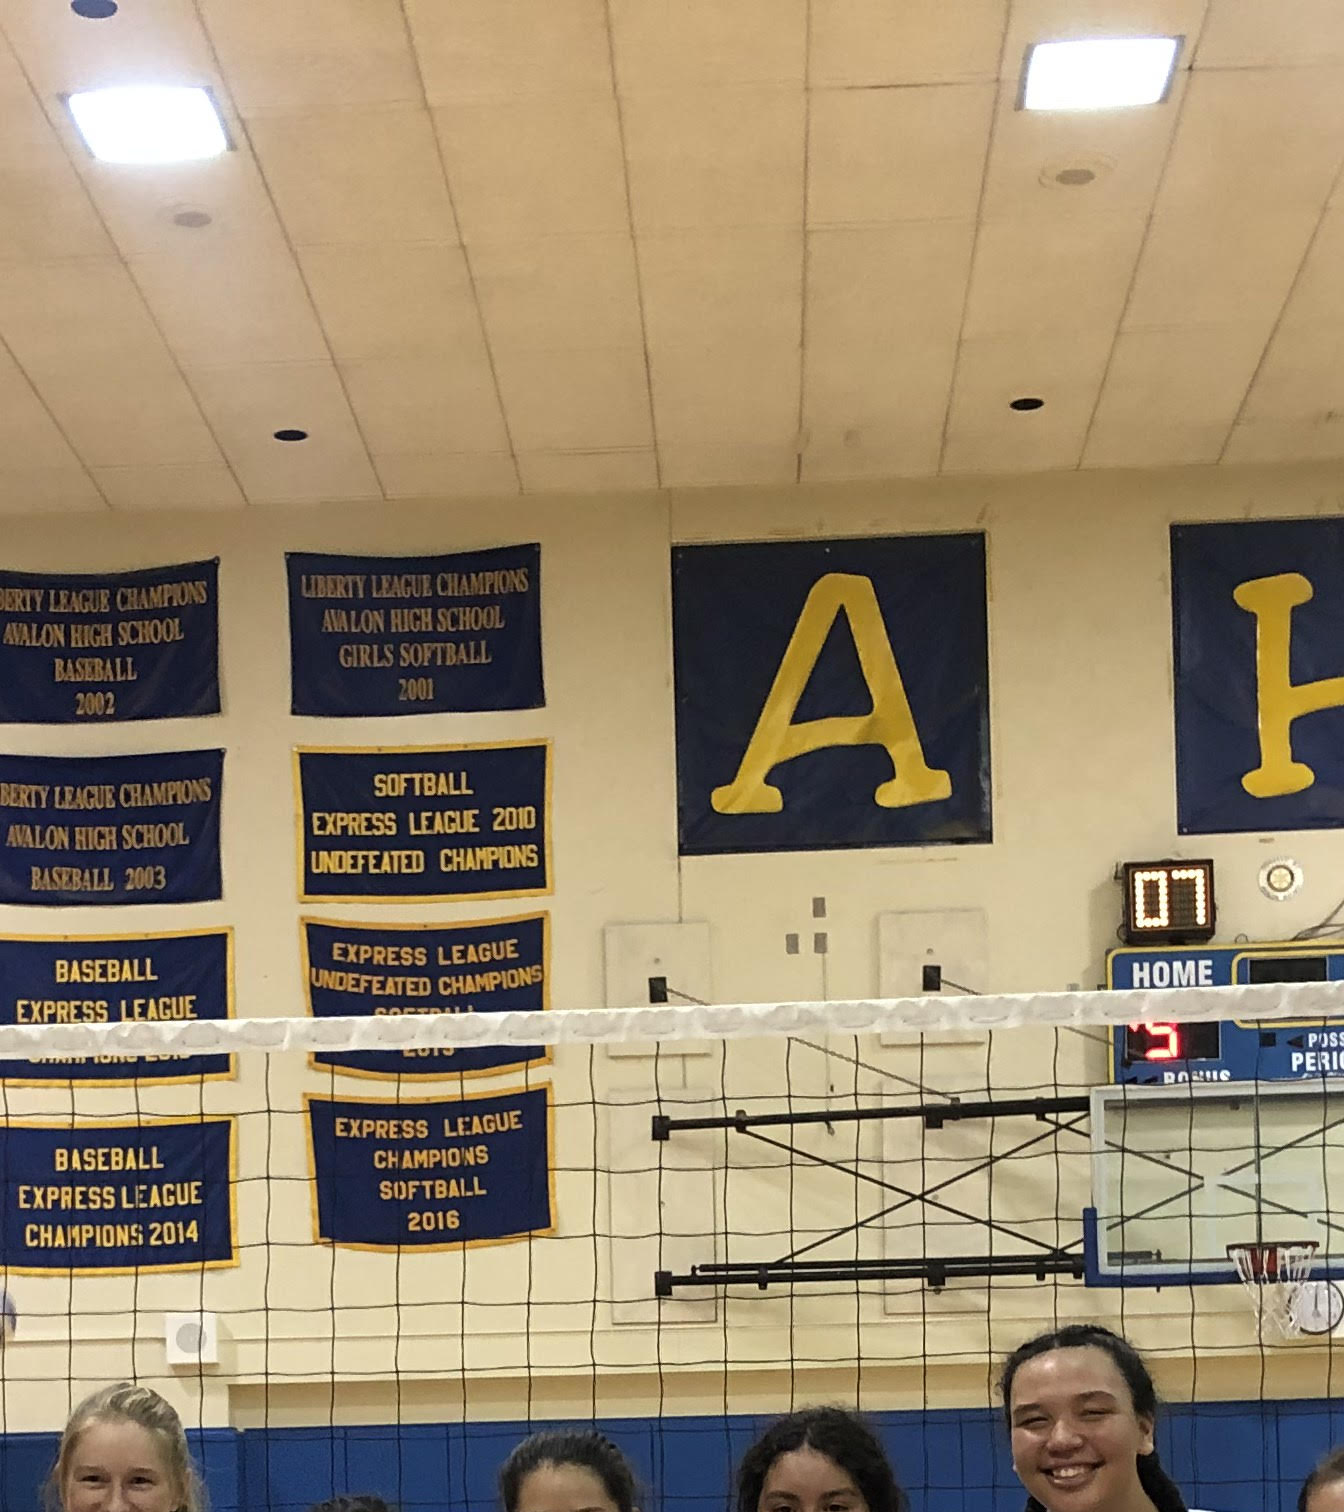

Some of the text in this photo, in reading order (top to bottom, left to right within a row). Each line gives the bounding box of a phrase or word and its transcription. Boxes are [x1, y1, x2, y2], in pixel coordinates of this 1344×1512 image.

[301, 568, 529, 598] LIBERTY LEAGUE CHAMPIONS
[322, 606, 505, 633] AVALON HIGH SCHOOL
[339, 640, 492, 668] GIRLS SOFTBALL
[399, 678, 434, 701] 2001
[711, 572, 952, 814] A
[54, 785, 115, 810] LEAGUE
[120, 778, 212, 808] CHAMPIONS
[374, 772, 474, 797] SOFTBALL
[312, 806, 536, 836] EXPRESS LEAGUE 2010
[7, 823, 189, 850] AVALON HIGH SCHOOL
[311, 845, 538, 874] UNDEFEATED CHAMPIONS
[31, 866, 166, 891] BASEBALL 2003
[1132, 960, 1213, 987] HOME
[335, 1110, 523, 1139] EXPRESS LEAGUE
[55, 1147, 164, 1171] BASEBALL
[374, 1145, 489, 1169] CHAMPIONS
[19, 1181, 202, 1210] EXPRESS LEAGUE
[379, 1177, 487, 1200] SOFTBALL
[25, 1220, 199, 1248] CHAMPIONS 2014
[408, 1210, 460, 1231] 2016
